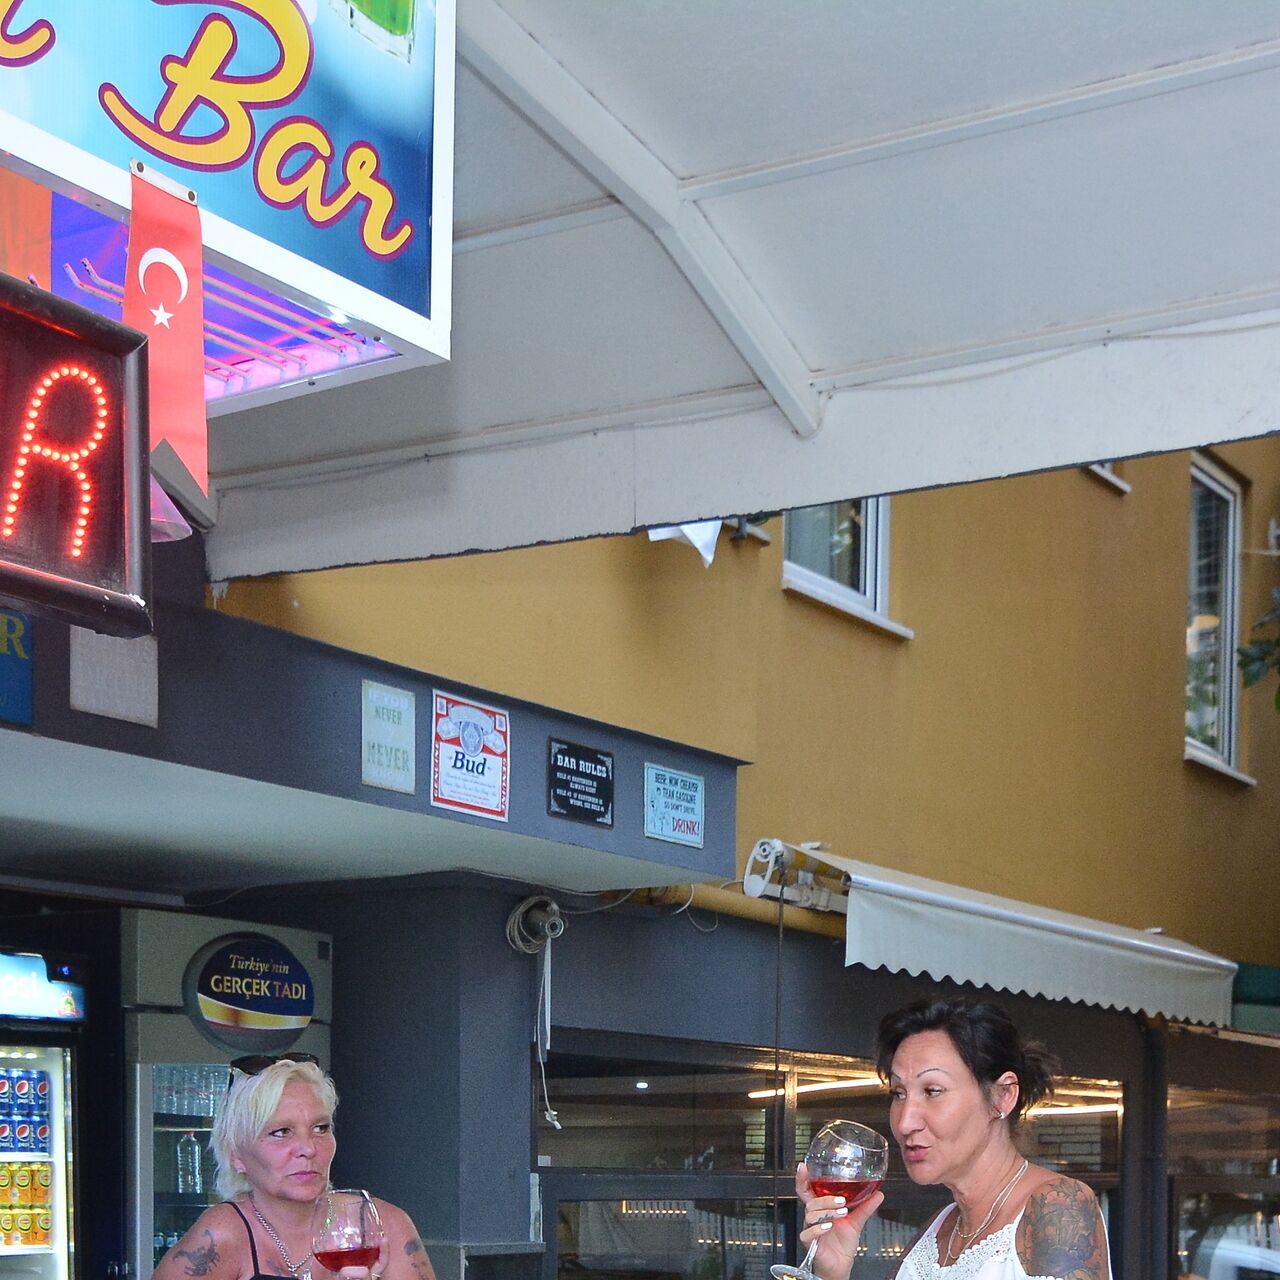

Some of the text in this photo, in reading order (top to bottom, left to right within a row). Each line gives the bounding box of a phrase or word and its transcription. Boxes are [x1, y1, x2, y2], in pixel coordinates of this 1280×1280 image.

[99, 0, 414, 262] Bar
[375, 704, 402, 726] NEVER
[367, 740, 409, 772] NEVER
[451, 750, 487, 776] Bud
[557, 754, 607, 778] BAR RULES
[672, 817, 700, 837] DRINK!
[210, 974, 307, 1001] GERÇEK TADI
